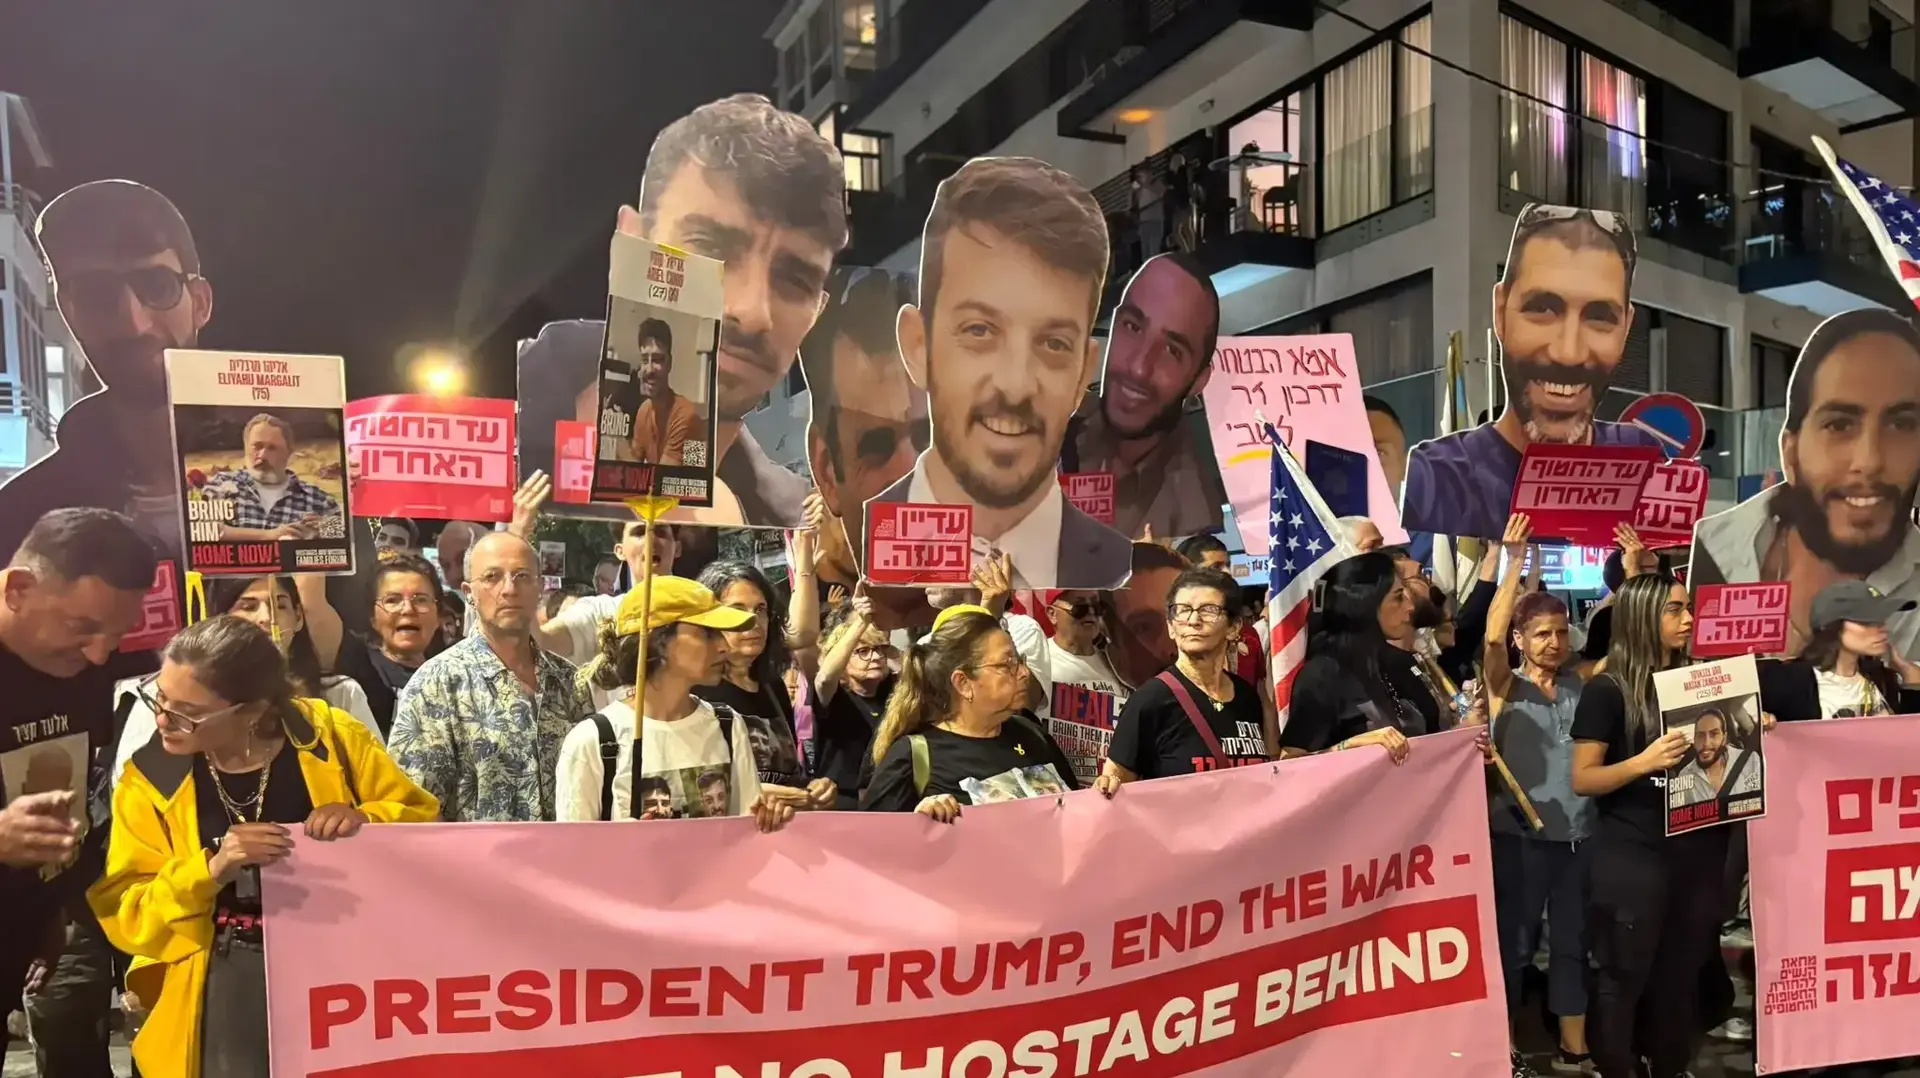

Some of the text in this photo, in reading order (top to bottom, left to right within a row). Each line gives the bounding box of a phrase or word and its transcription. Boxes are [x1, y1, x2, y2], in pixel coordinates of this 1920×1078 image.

[648, 284, 667, 301] (27)
[1286, 346, 1346, 378] אמא
[218, 372, 300, 387] ELIYAHU MARGALIT
[252, 387, 270, 400] (75)
[1281, 384, 1342, 416] דרכון
[349, 416, 500, 443] עד החטוף
[600, 409, 630, 436] BRING
[361, 449, 483, 479] האחרון
[1531, 460, 1642, 479] עד החטוף
[685, 486, 707, 498] FORUM
[1072, 477, 1111, 496] עדיין
[1533, 486, 1621, 506] האחרון
[189, 499, 234, 520] BRING
[1635, 502, 1694, 530] בעז
[190, 521, 220, 542] HIM
[901, 510, 965, 537] עדיין
[192, 541, 281, 565] HOME NOW!
[883, 544, 965, 567] בעזה.
[1725, 588, 1784, 614] עדיין
[1706, 618, 1781, 641] בעזה.
[1055, 682, 1114, 730] DEAL
[40, 713, 69, 736] אלעד
[1053, 720, 1078, 737] BRING
[1080, 725, 1102, 743] THEM
[1669, 775, 1694, 793] BRING
[1669, 791, 1685, 808] HIM
[1669, 807, 1692, 825] HOME
[1694, 798, 1719, 819] NOW!
[309, 958, 824, 1050] PRESIDENT
[847, 930, 1093, 1006] TRUMP,
[1111, 899, 1224, 969] END
[1237, 870, 1327, 933] THE
[1342, 844, 1435, 908] WAR
[1780, 966, 1817, 980] הנשים
[1781, 955, 1817, 969] מחאת
[1766, 988, 1817, 1004] החטופות
[1769, 976, 1817, 993] להחזרת
[883, 927, 1471, 1078] HOSTAGE BEHIND
[1764, 999, 1817, 1015] והחטופים
